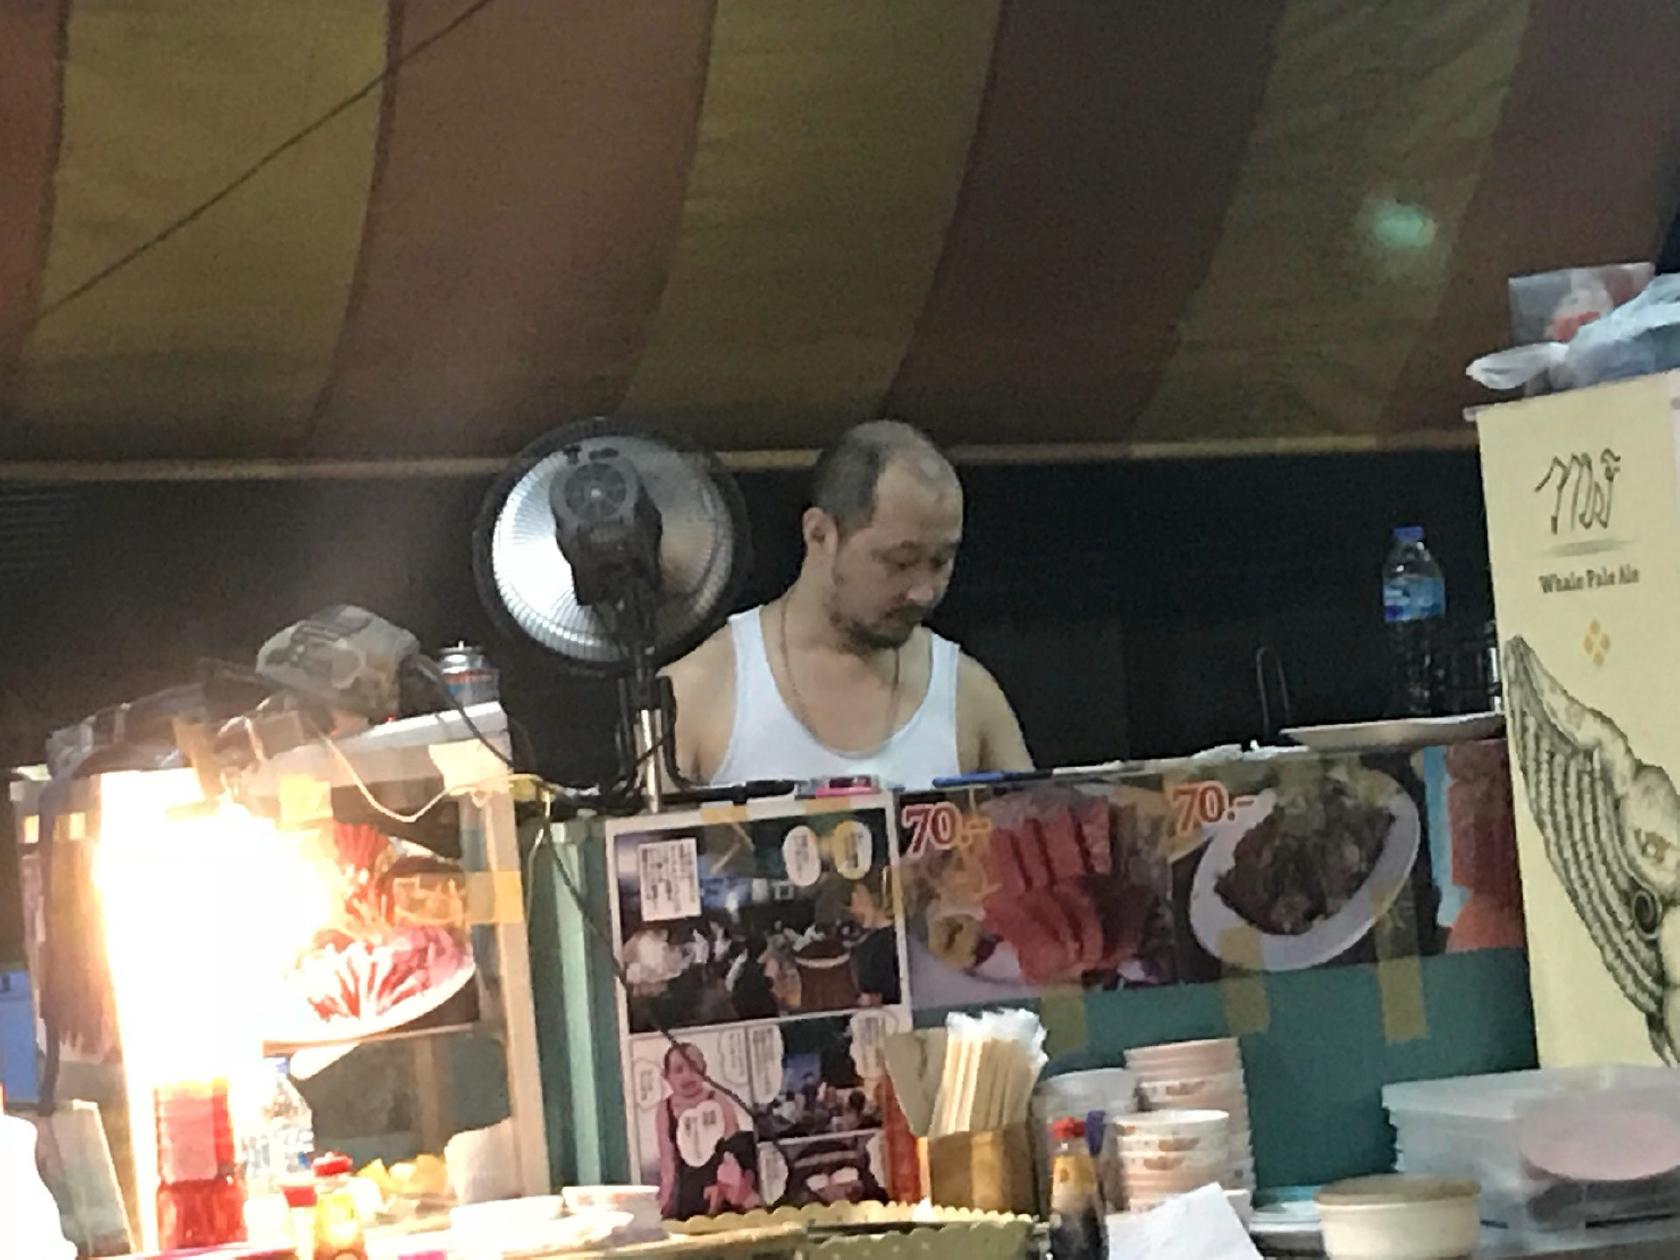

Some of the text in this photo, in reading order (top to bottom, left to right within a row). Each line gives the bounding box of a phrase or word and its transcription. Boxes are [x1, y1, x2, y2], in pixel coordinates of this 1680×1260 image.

[1539, 564, 1639, 593] Whale Pale Ale
